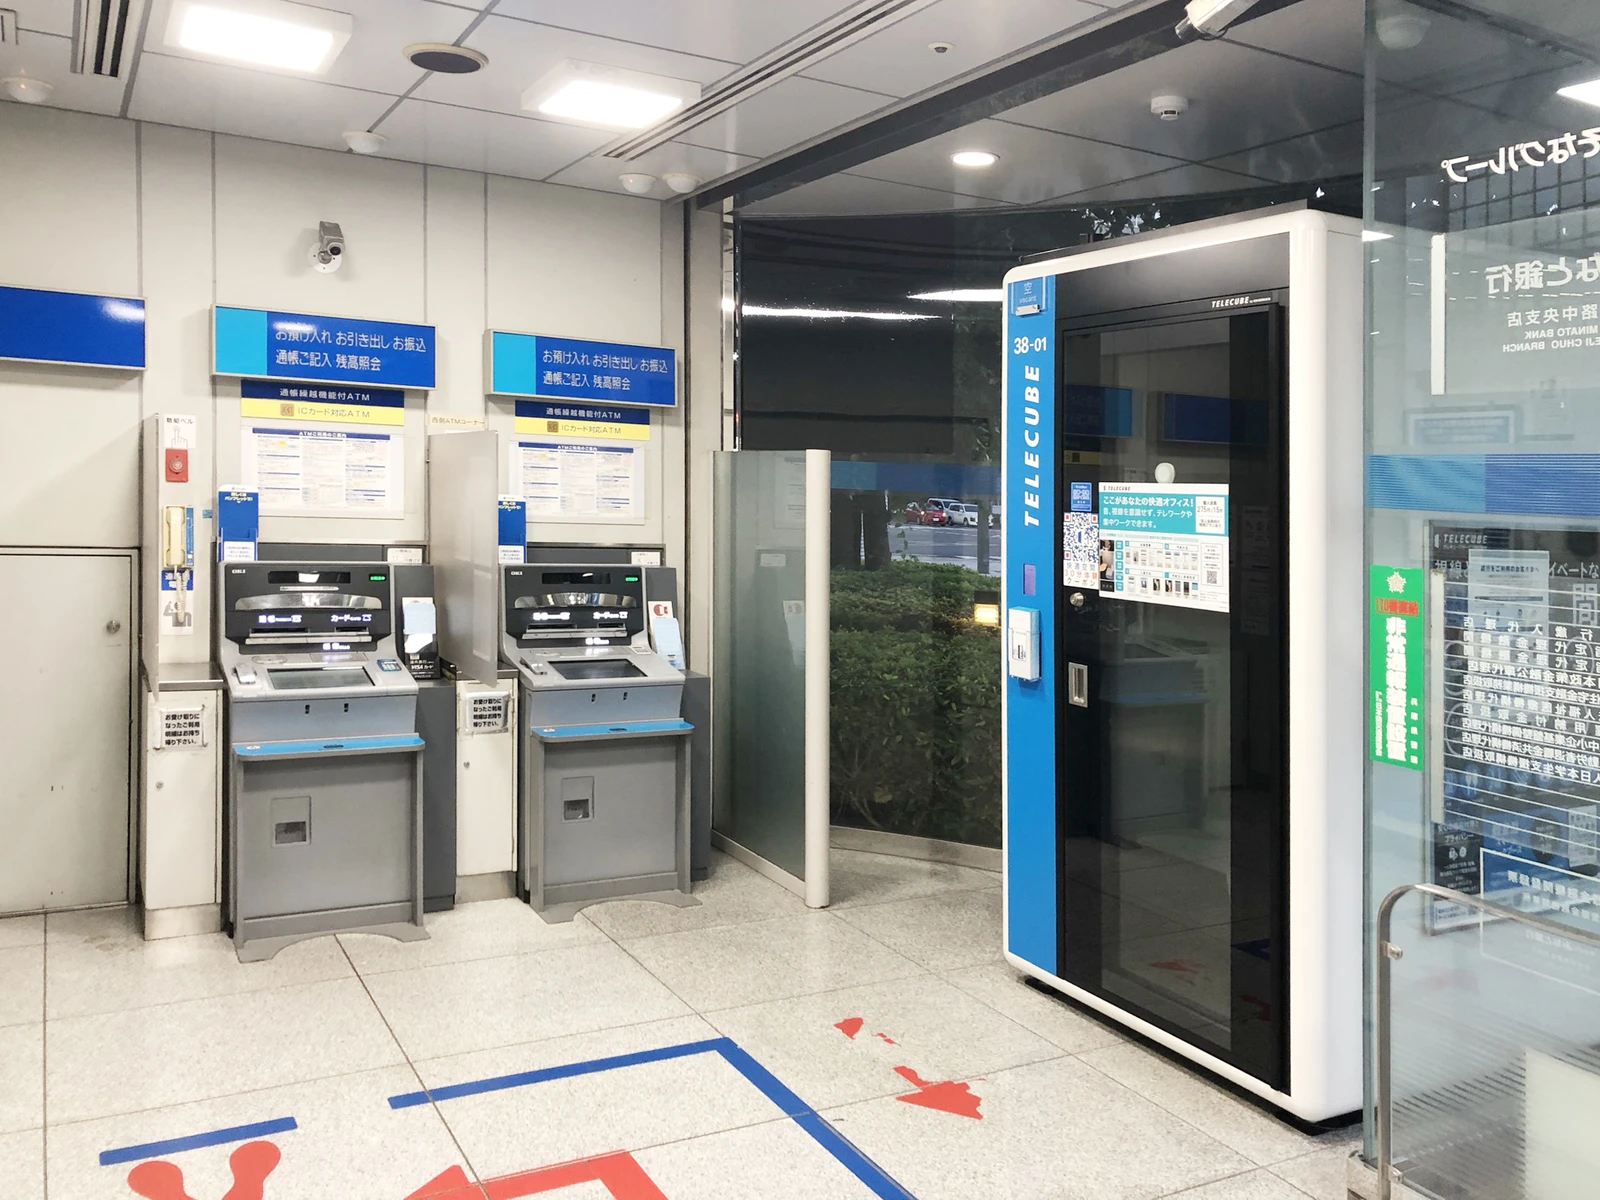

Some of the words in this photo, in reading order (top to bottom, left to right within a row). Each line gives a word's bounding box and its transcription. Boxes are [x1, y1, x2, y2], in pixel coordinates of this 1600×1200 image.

[1211, 296, 1250, 308] TELECUBE
[275, 327, 332, 345] お預け入れ
[335, 330, 390, 348] お引き出し
[392, 335, 427, 353] お振込
[1013, 337, 1047, 354] 38-01
[275, 349, 332, 368] 通帳ご記入
[335, 354, 381, 372] 残高照会
[542, 350, 590, 367] お預け入れ
[592, 353, 638, 371] お引き出し
[639, 358, 668, 373] お振込
[543, 371, 590, 388] 通帳ご記入
[592, 374, 631, 391] 残高照会
[1024, 365, 1040, 527] TELECUBE
[1443, 534, 1488, 545] TELECUBE
